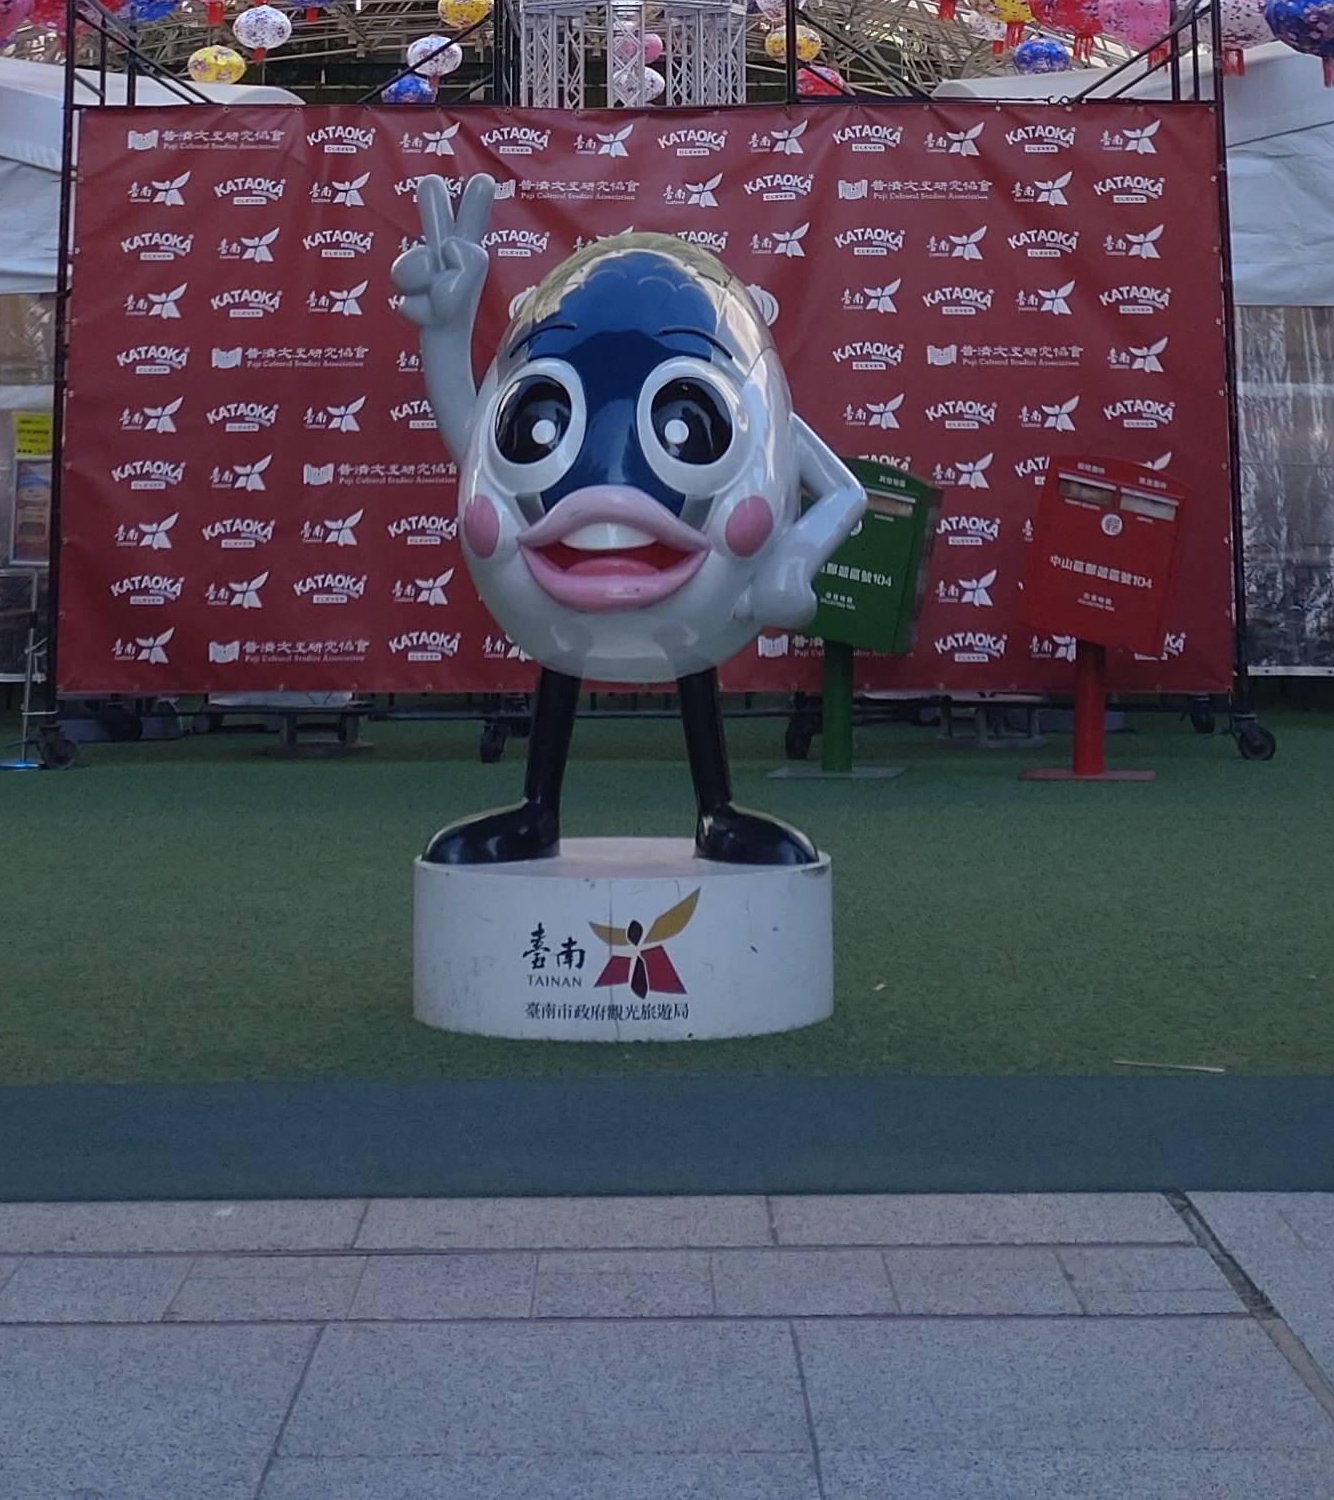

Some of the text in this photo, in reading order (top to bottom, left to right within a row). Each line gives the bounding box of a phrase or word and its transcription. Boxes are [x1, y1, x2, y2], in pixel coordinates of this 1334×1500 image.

[305, 126, 375, 145] KATAOKA
[480, 126, 550, 146] KATAOKA
[657, 128, 727, 148] KATAOKA
[832, 124, 902, 144] KATAOKA
[1005, 126, 1075, 145] KATAOKA
[214, 178, 284, 197] KATAOKA
[743, 174, 813, 193] KATAOKA
[1093, 176, 1163, 195] KATAOKA
[122, 232, 192, 252] KATAOKA
[302, 230, 372, 250] KATAOKA
[834, 228, 904, 247] KATAOKA
[1008, 230, 1078, 249] KATAOKA
[211, 290, 281, 309] KATAOKA
[923, 288, 993, 307] KATAOKA
[1100, 286, 1170, 306] KATAOKA
[115, 346, 190, 366] KATAOKA
[833, 342, 903, 362] KATAOKA
[207, 404, 277, 423] KATAOKA
[925, 400, 995, 420] KATAOKA
[1104, 400, 1174, 420] KATAOKA
[111, 461, 186, 481] KATAOKA
[201, 519, 276, 539] KATAOKA
[388, 516, 458, 536] KATAOKA
[936, 516, 999, 536] ATAOKA
[109, 576, 184, 596] KATAOKA
[292, 575, 367, 595] KATAOKA
[389, 632, 459, 652] KATAOKA
[933, 633, 1008, 653] KATAOKA
[522, 922, 586, 971] 臺南
[527, 974, 582, 988] TAINAN
[525, 1002, 689, 1022] 臺南市政府觀光旅遊局
